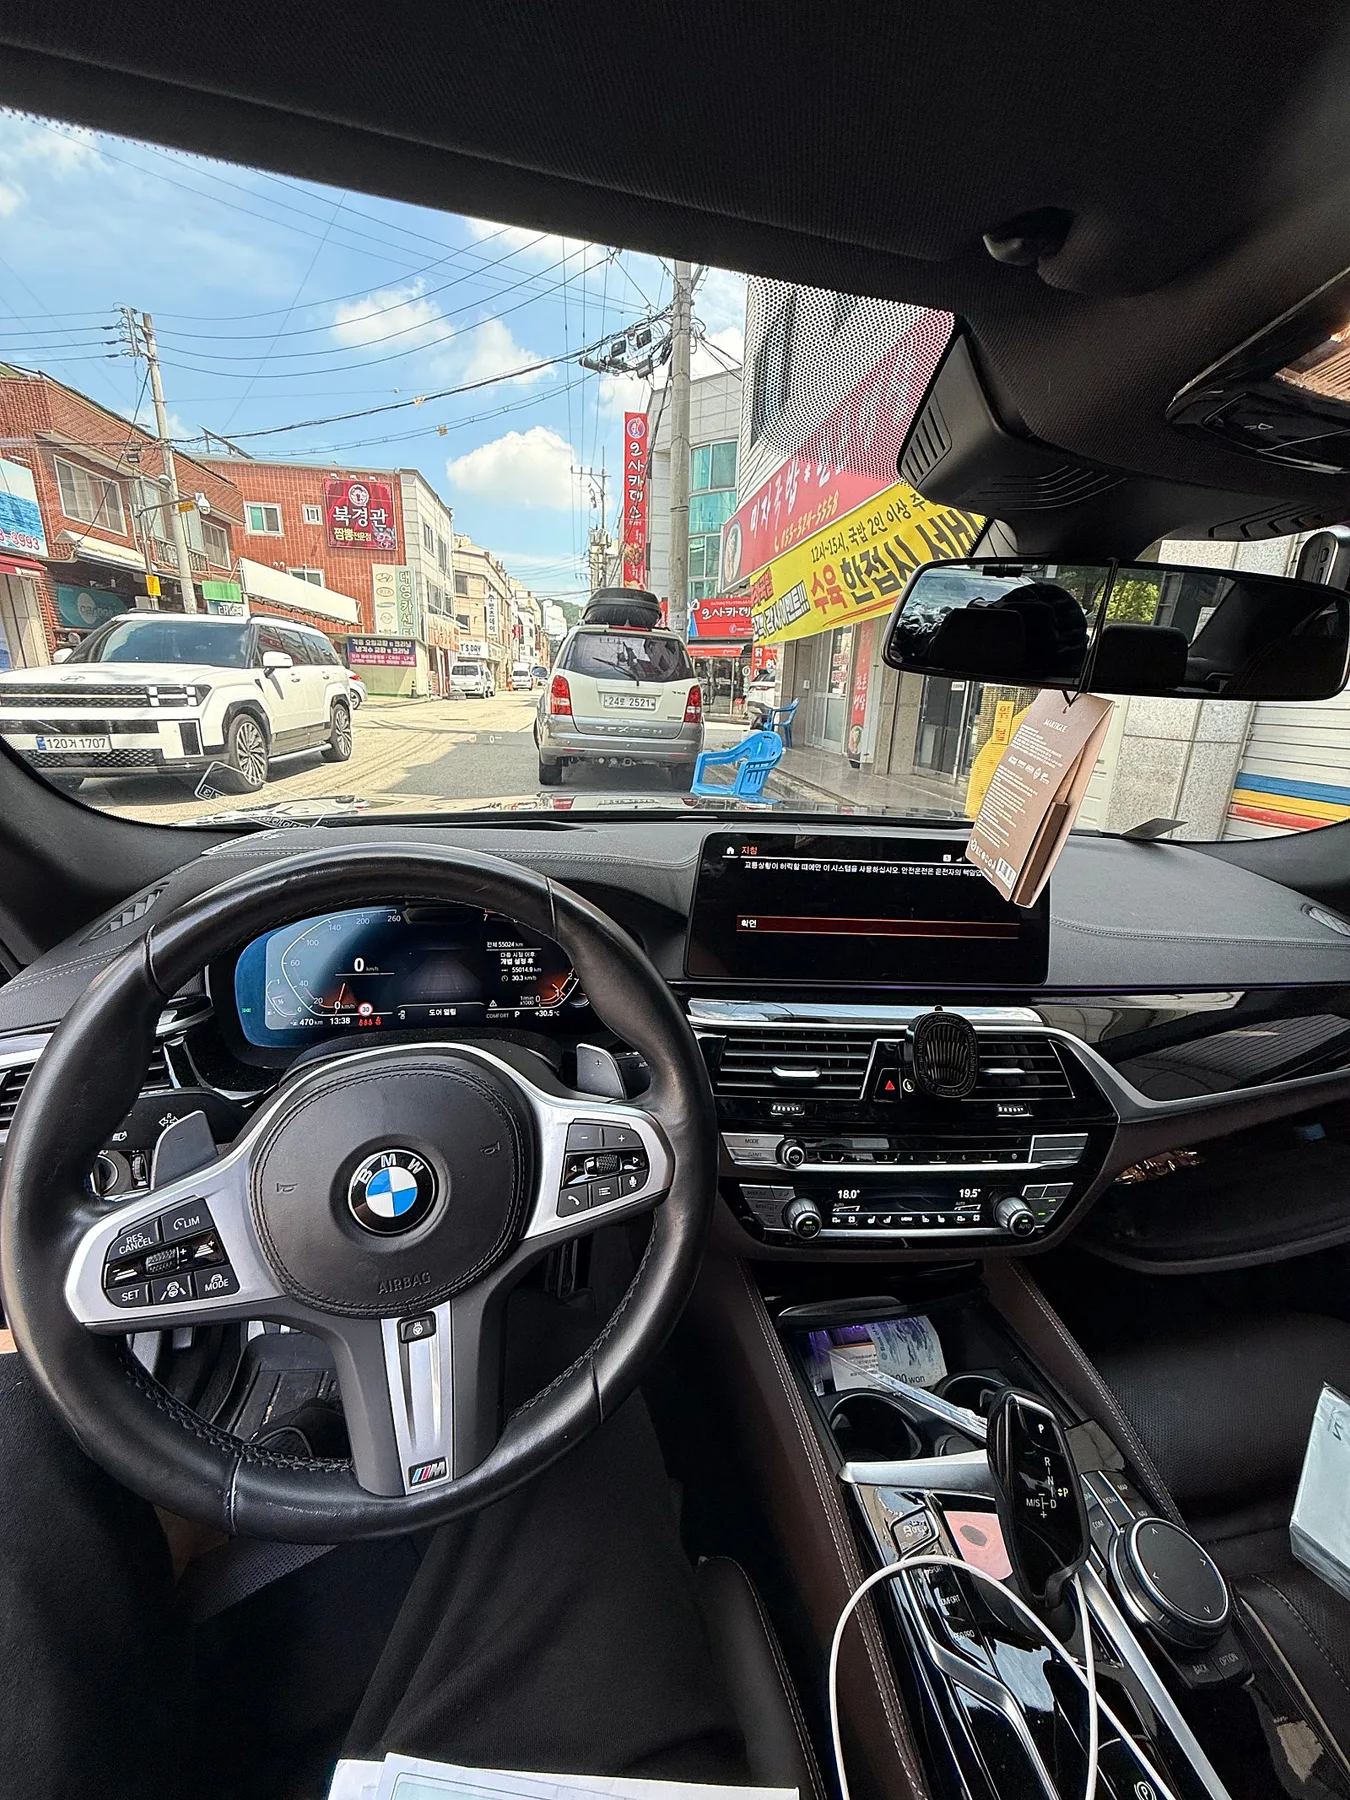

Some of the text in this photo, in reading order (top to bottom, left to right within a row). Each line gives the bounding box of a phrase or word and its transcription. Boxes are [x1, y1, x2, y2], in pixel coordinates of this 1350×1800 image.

[628, 442, 645, 519] 오사카데스
[333, 505, 388, 528] 북경관
[848, 521, 868, 547] 국밥
[867, 511, 888, 537] 2인
[886, 498, 912, 524] 이상
[810, 564, 848, 614] 수육
[629, 697, 651, 709] 2521
[79, 736, 106, 749] 1707
[823, 864, 830, 872] 이
[831, 864, 858, 873] 시스템을
[901, 867, 934, 875] 안전운전은
[935, 868, 962, 876] 운전자의
[483, 913, 488, 922] 7
[741, 919, 757, 928] 확인
[353, 957, 365, 972] 0
[535, 995, 541, 1003] 0
[334, 1001, 341, 1010] 0
[428, 1009, 443, 1017] 도어
[514, 1010, 521, 1018] P
[534, 1010, 554, 1018] +30.5
[299, 1018, 314, 1026] 470
[329, 1017, 351, 1026] 13:38
[354, 1153, 424, 1187] BMW
[183, 1215, 201, 1229] LIM
[1018, 1222, 1032, 1230] AUTO
[802, 1224, 816, 1232] AUTO
[126, 1232, 144, 1245] RES
[119, 1236, 154, 1255] CANCEL
[204, 1278, 229, 1292] MODE
[378, 1271, 431, 1295] AIRBAG
[121, 1289, 140, 1302] SET
[908, 1374, 926, 1384] won
[1038, 1424, 1045, 1434] P
[1044, 1456, 1051, 1466] R
[1047, 1475, 1054, 1486] N
[1063, 1487, 1069, 1498] P
[1026, 1498, 1041, 1508] M/S
[1050, 1499, 1057, 1509] D
[1102, 1496, 1118, 1505] MENU
[1092, 1520, 1105, 1529] COM
[940, 1594, 961, 1606] OMFORT
[1218, 1652, 1240, 1667] OPTION
[1192, 1663, 1210, 1675] BACK
